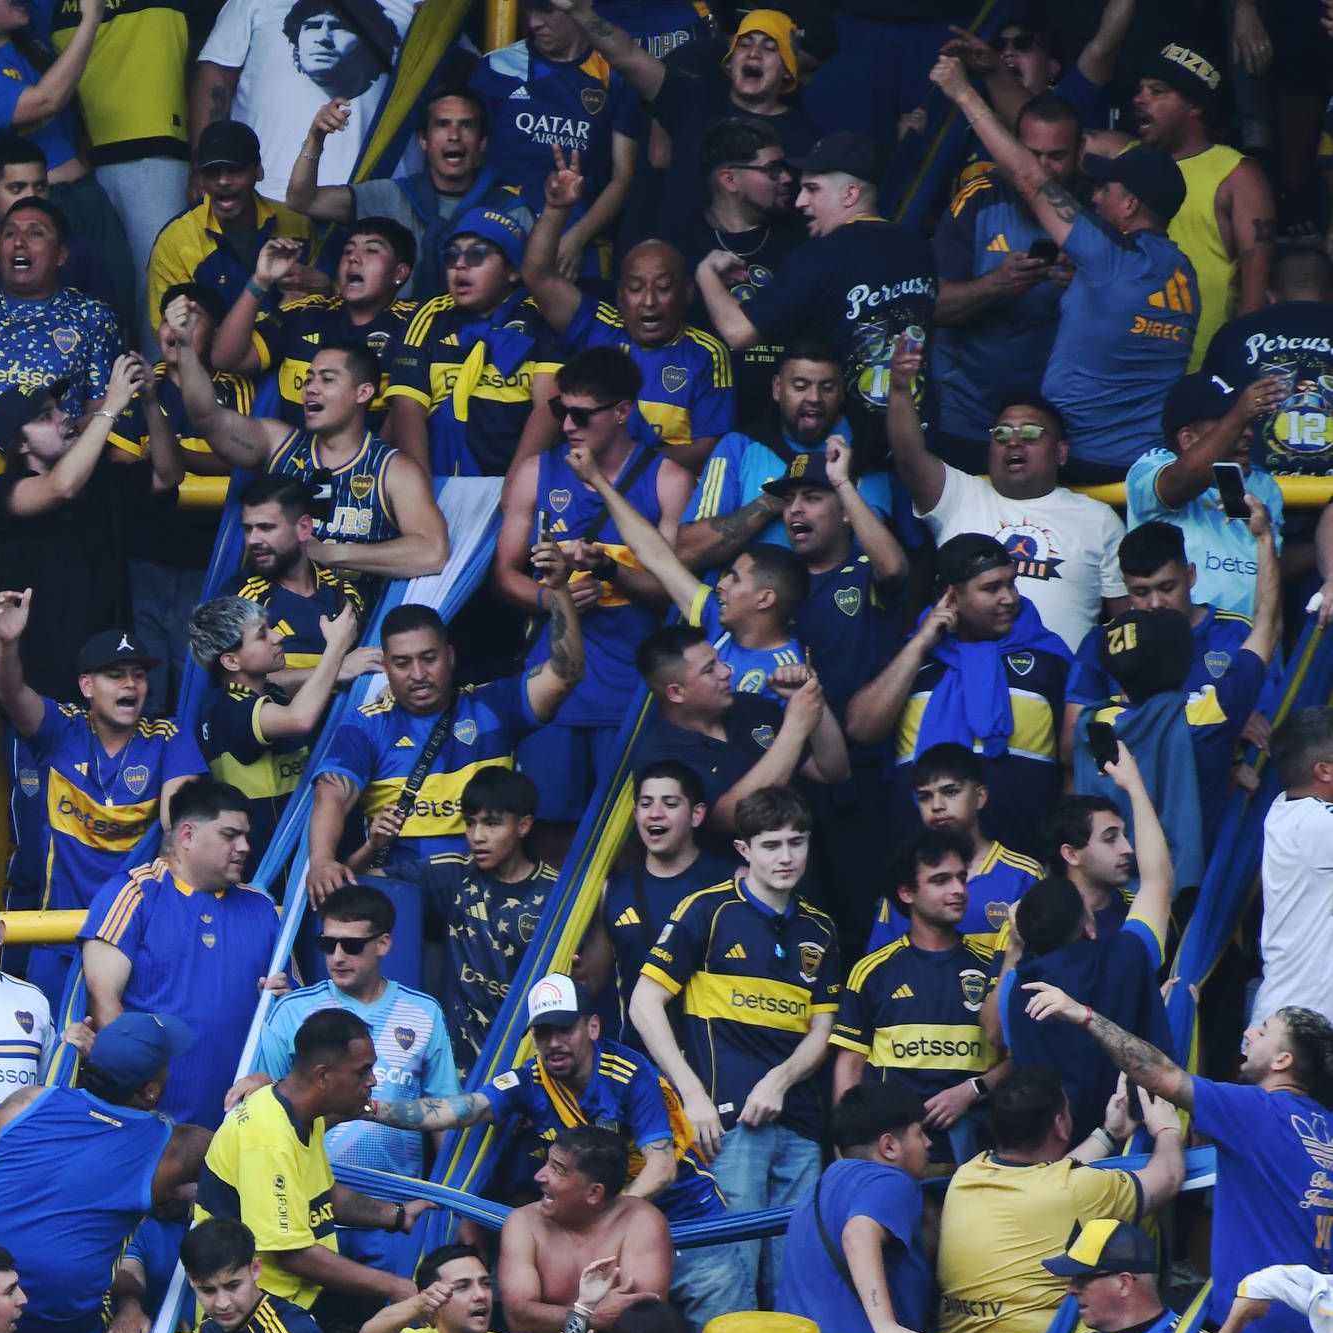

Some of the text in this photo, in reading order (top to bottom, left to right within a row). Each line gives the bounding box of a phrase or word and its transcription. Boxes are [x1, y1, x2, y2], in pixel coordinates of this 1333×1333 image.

[1161, 43, 1221, 89] EIZES
[516, 113, 590, 140] QATAR
[532, 133, 587, 152] AIRWAYS
[847, 276, 934, 319] Percusi
[1130, 317, 1187, 341] DIREC
[1246, 332, 1333, 364] Percus
[445, 369, 531, 390] bsson
[1288, 411, 1326, 446] 12
[1205, 551, 1258, 576] bets
[731, 989, 806, 1017] betsson
[892, 1035, 980, 1061] betsson
[277, 1192, 289, 1235] unicef
[944, 1300, 1002, 1317] DIRECTV
